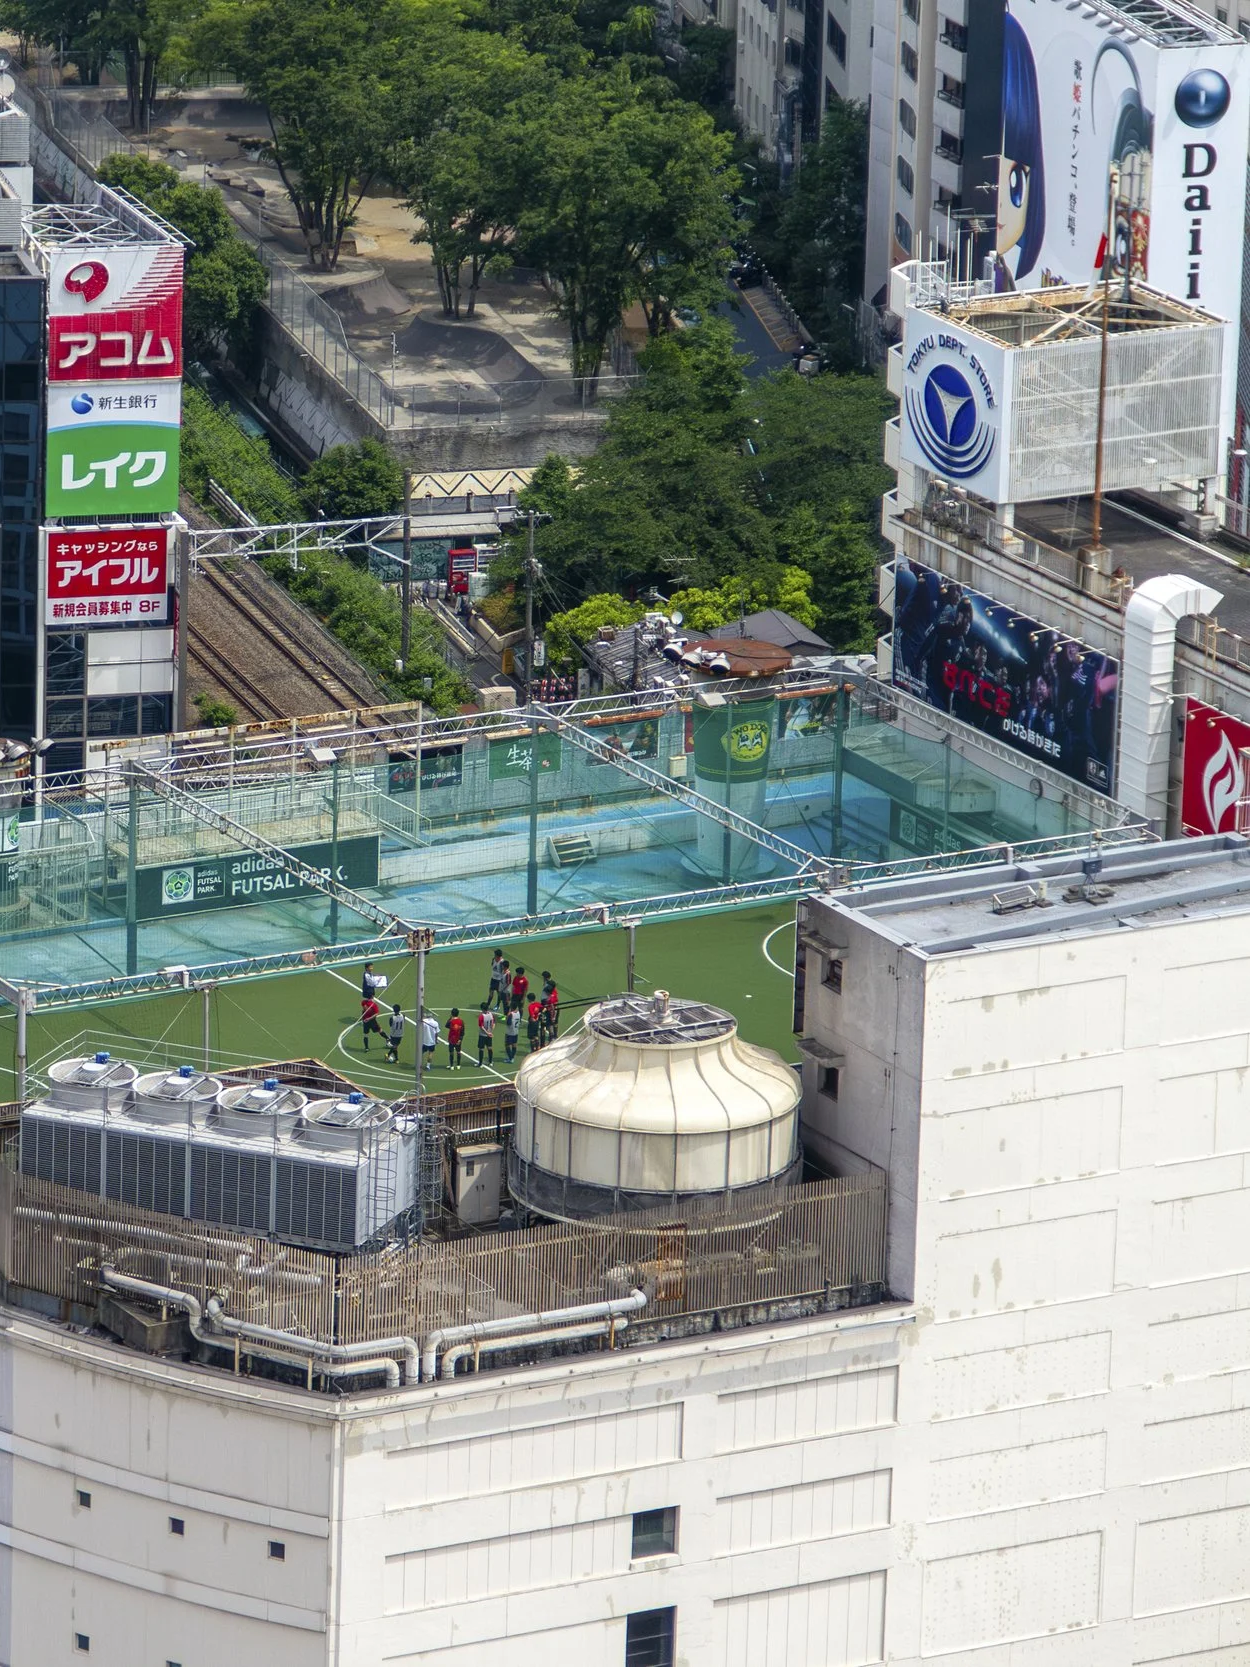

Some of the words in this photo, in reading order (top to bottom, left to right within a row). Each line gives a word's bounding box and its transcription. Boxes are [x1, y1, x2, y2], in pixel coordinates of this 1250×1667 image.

[1182, 142, 1218, 308] Daii
[59, 329, 175, 369] アコム
[907, 335, 936, 374] TOKYU
[969, 354, 998, 410] STORE
[98, 394, 158, 411] 新生銀行
[61, 450, 167, 490] レイク
[56, 540, 158, 555] キャッシングなら
[55, 557, 159, 588] アイフル
[52, 601, 132, 618] 新規会員募集中
[139, 599, 160, 613] 8F
[197, 876, 223, 886] FUTSAL
[231, 872, 295, 896] FUTSAL
